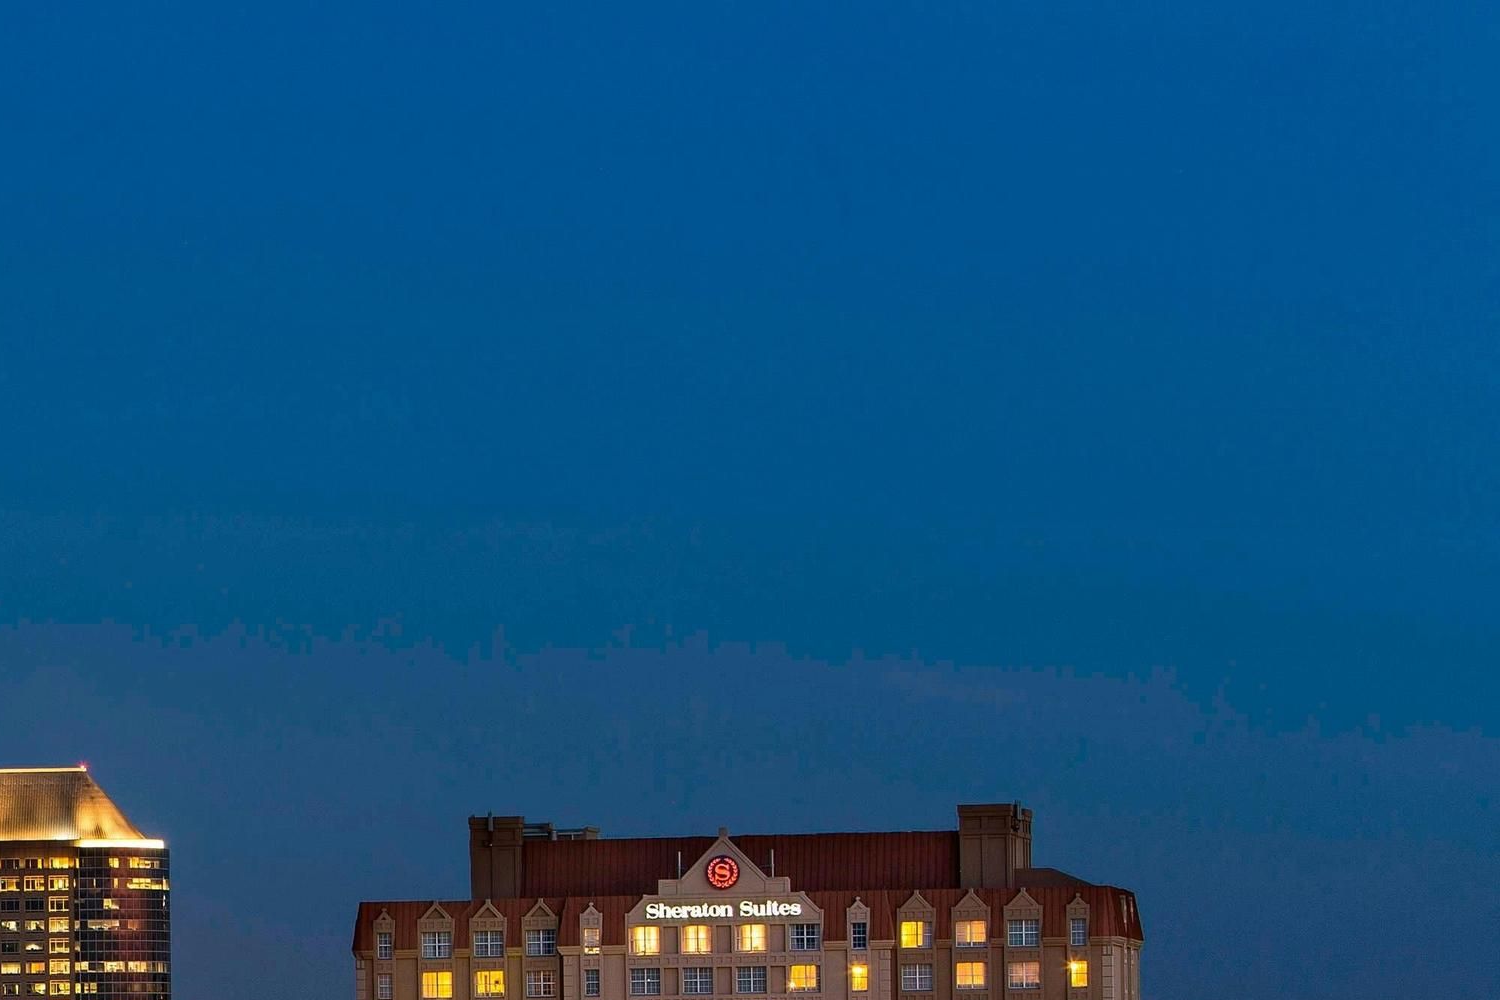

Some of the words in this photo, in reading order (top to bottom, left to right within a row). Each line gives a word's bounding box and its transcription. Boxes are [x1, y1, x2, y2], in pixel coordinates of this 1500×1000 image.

[714, 863, 731, 881] S
[645, 902, 733, 919] Sheraton
[739, 900, 802, 917] Suites
